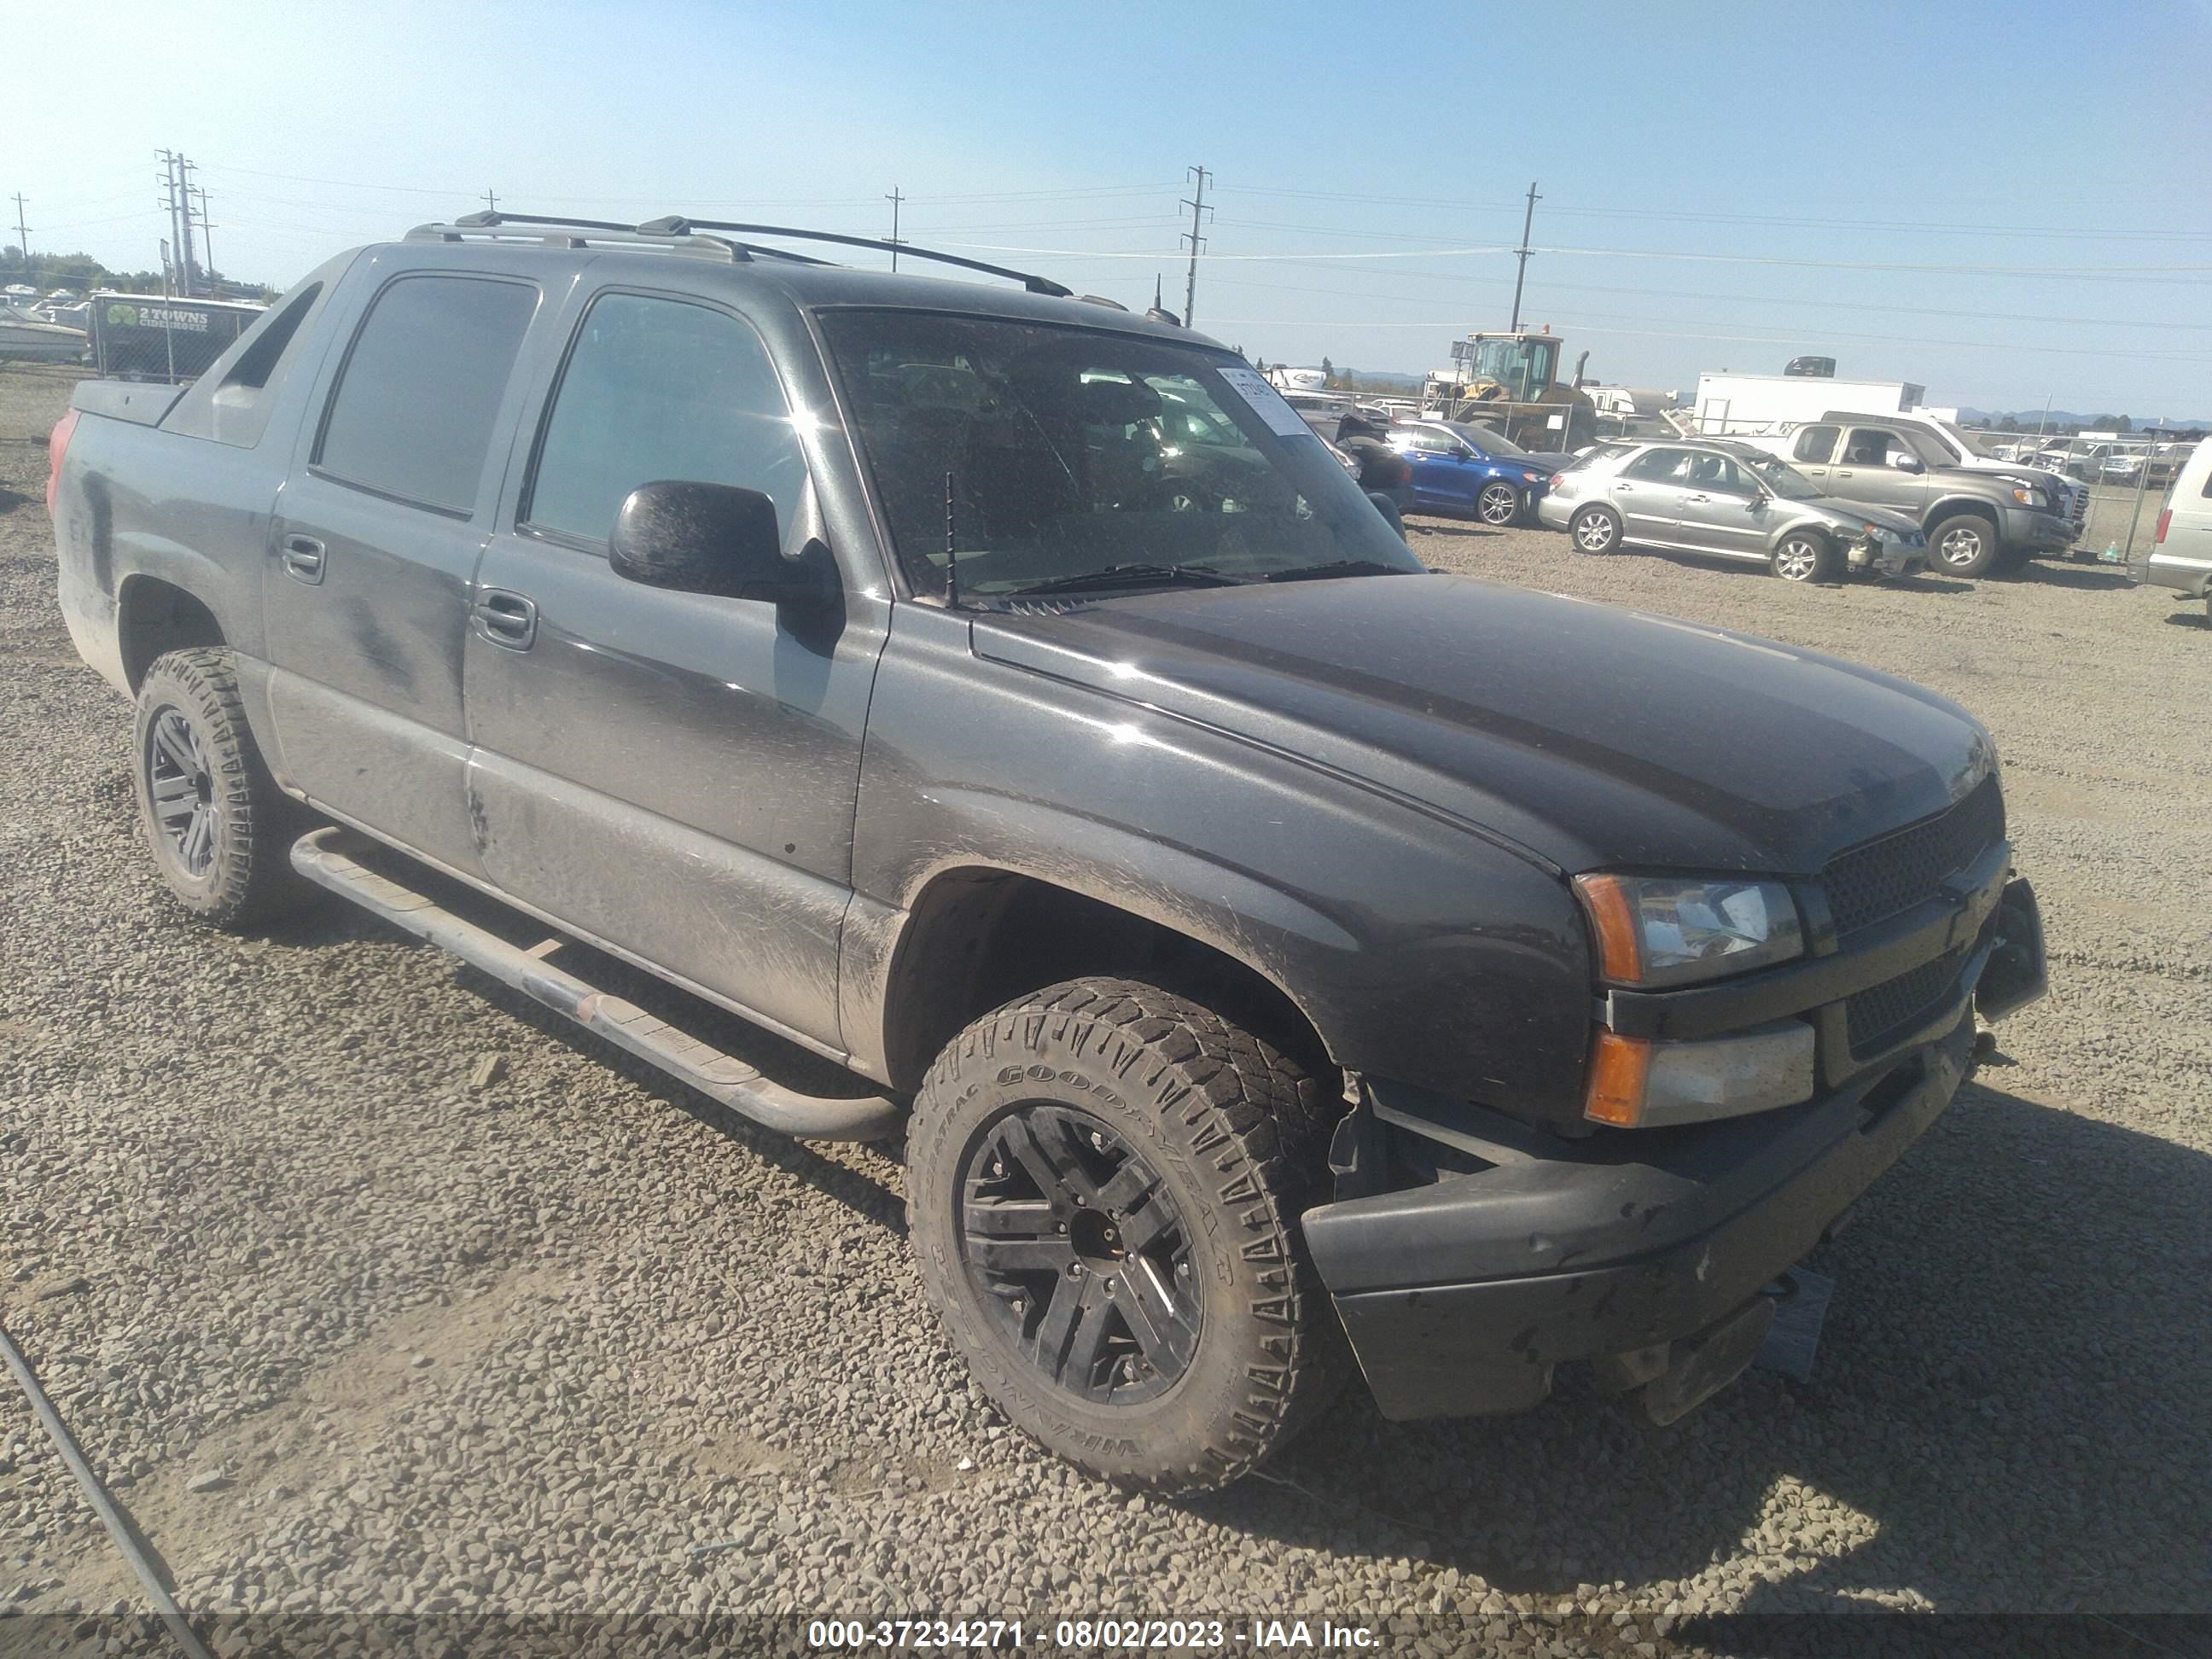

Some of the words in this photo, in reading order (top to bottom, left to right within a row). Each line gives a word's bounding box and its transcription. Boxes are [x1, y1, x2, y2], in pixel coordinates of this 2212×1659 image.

[140, 308, 148, 318] 2
[152, 310, 208, 324] TOWNS
[997, 1065, 1235, 1286] GOODYEAR
